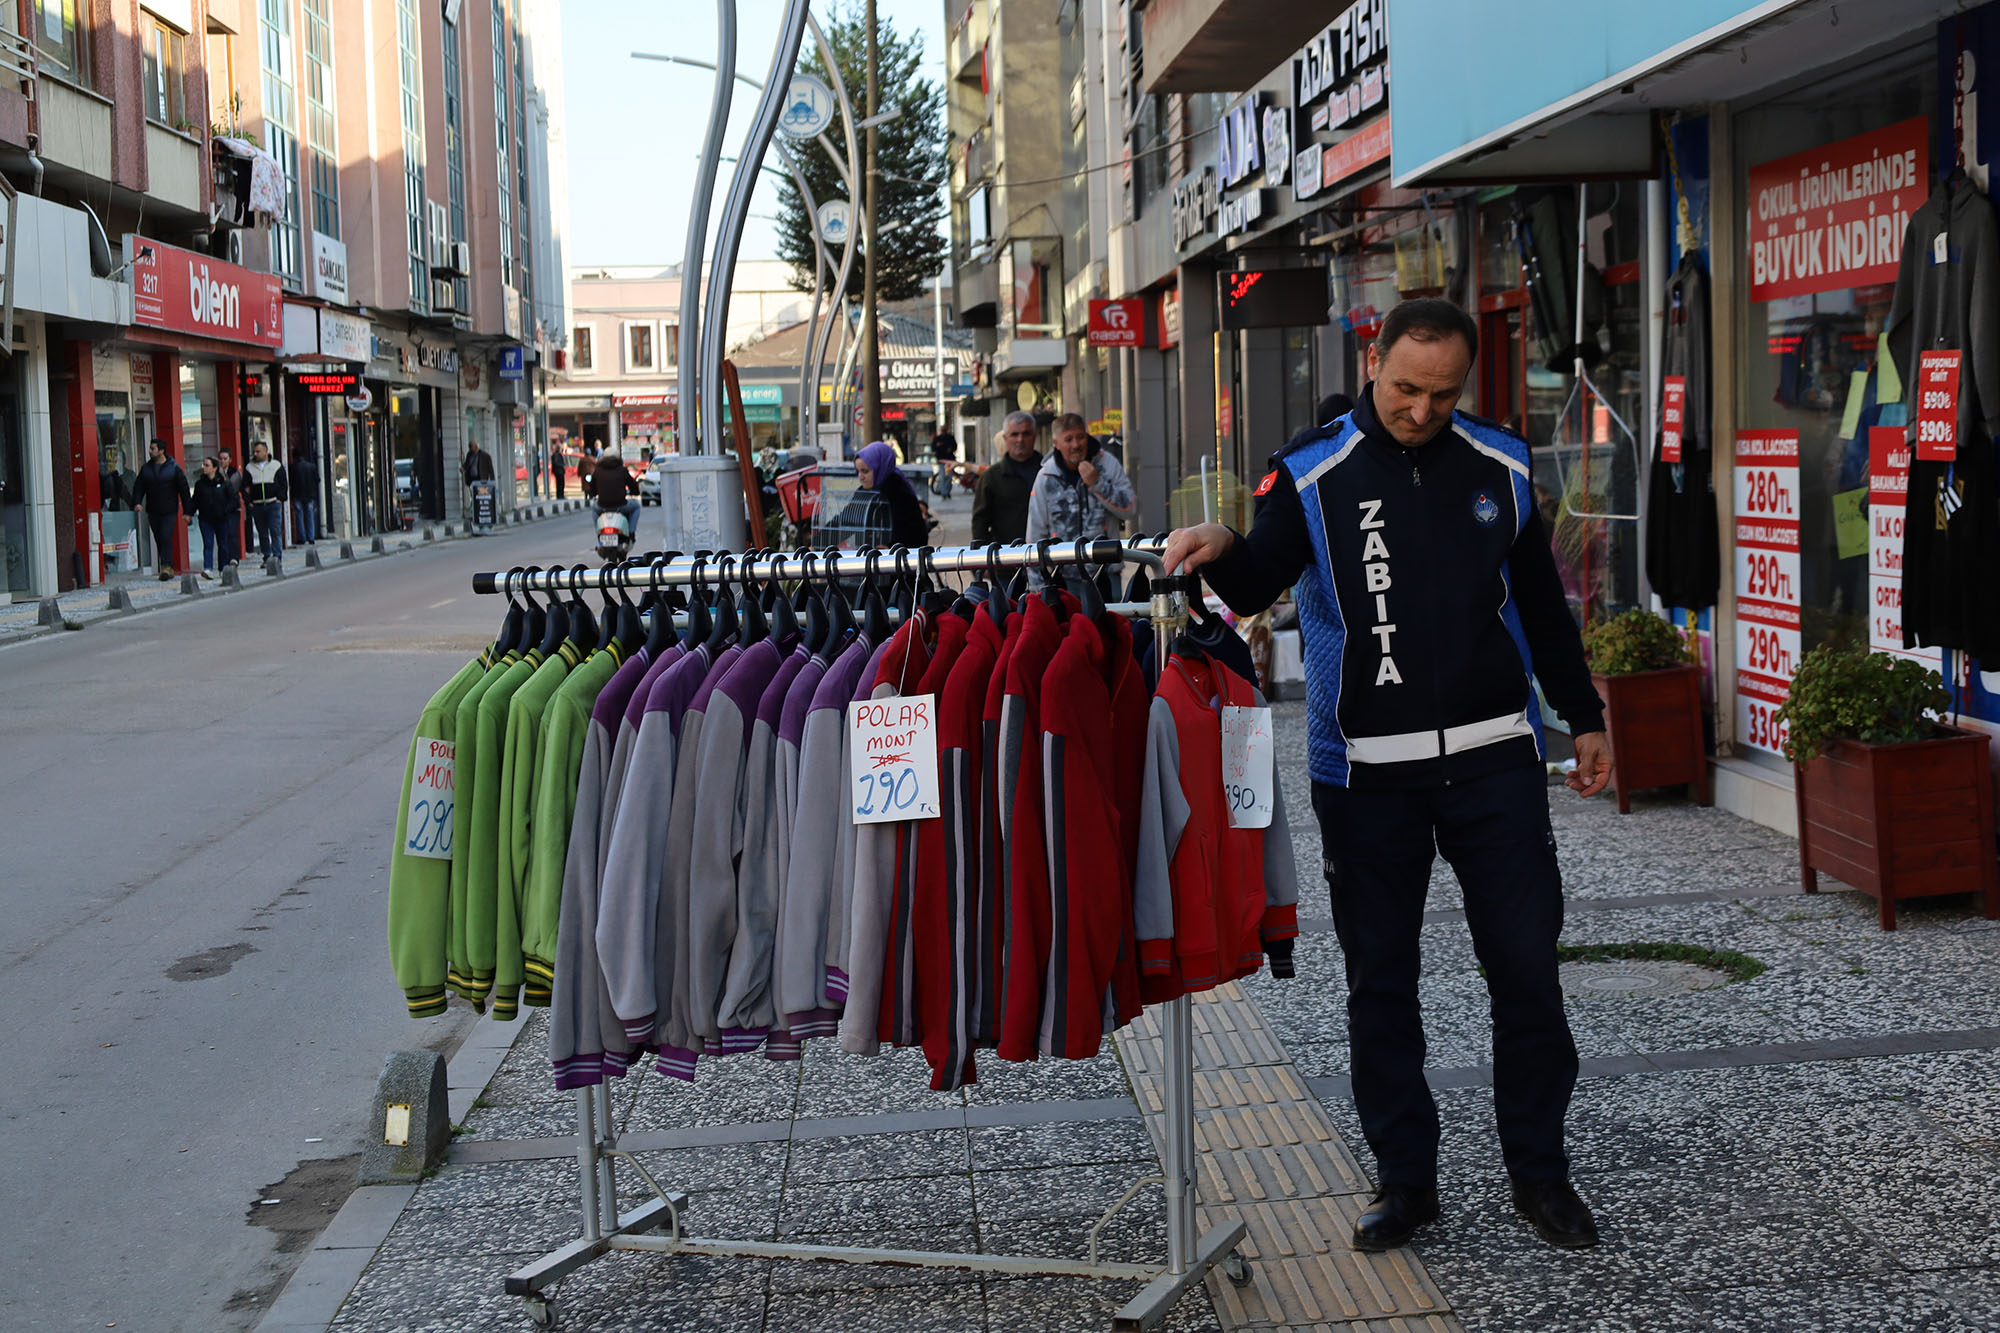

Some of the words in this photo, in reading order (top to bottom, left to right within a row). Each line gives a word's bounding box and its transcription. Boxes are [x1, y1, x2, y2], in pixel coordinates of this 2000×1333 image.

[1300, 28, 1335, 108] ADA
[1759, 182, 1797, 221] OKUL
[1800, 147, 1916, 212] ÜRÜNLERİNDE
[1754, 216, 1823, 286] BÜYÜK
[142, 272, 158, 294] 3217
[188, 260, 240, 329] bilenn
[892, 361, 934, 378] ÜNAL
[1922, 358, 1959, 370] KAPŞONLU
[326, 376, 355, 384] DOLUM
[1766, 438, 1798, 456] LACOSTE
[1875, 509, 1892, 538] İLK
[1768, 526, 1798, 545] LACOSTE
[1876, 547, 1882, 568] 1.
[1358, 499, 1403, 686] ZABITA
[1876, 617, 1883, 637] 1.
[856, 702, 929, 729] POLAR
[866, 730, 917, 752] MONT
[856, 767, 919, 815] 290
[920, 803, 936, 815] TL
